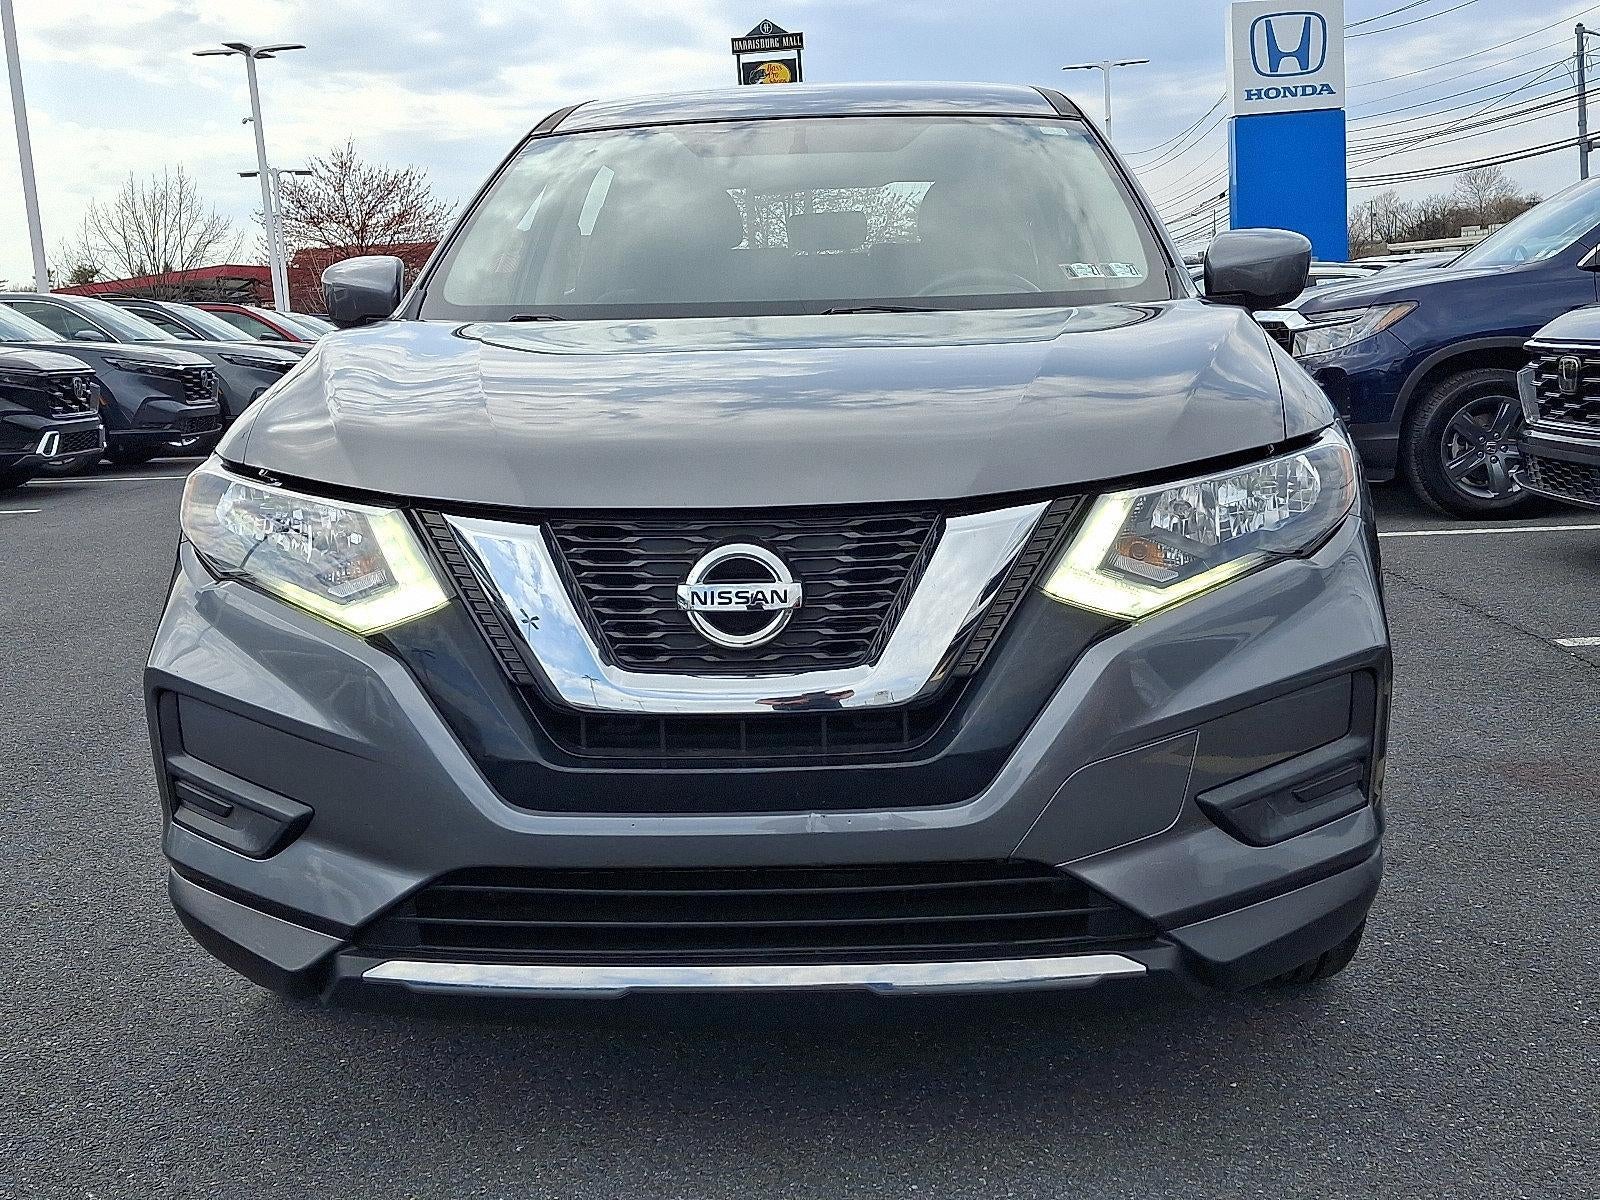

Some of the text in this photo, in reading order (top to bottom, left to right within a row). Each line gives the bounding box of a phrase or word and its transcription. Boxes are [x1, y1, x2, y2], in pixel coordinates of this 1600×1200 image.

[733, 35, 802, 51] HARRISBURG MALL
[767, 64, 783, 72] Bass
[1244, 83, 1336, 101] HONDA
[690, 589, 788, 606] NISSAN
